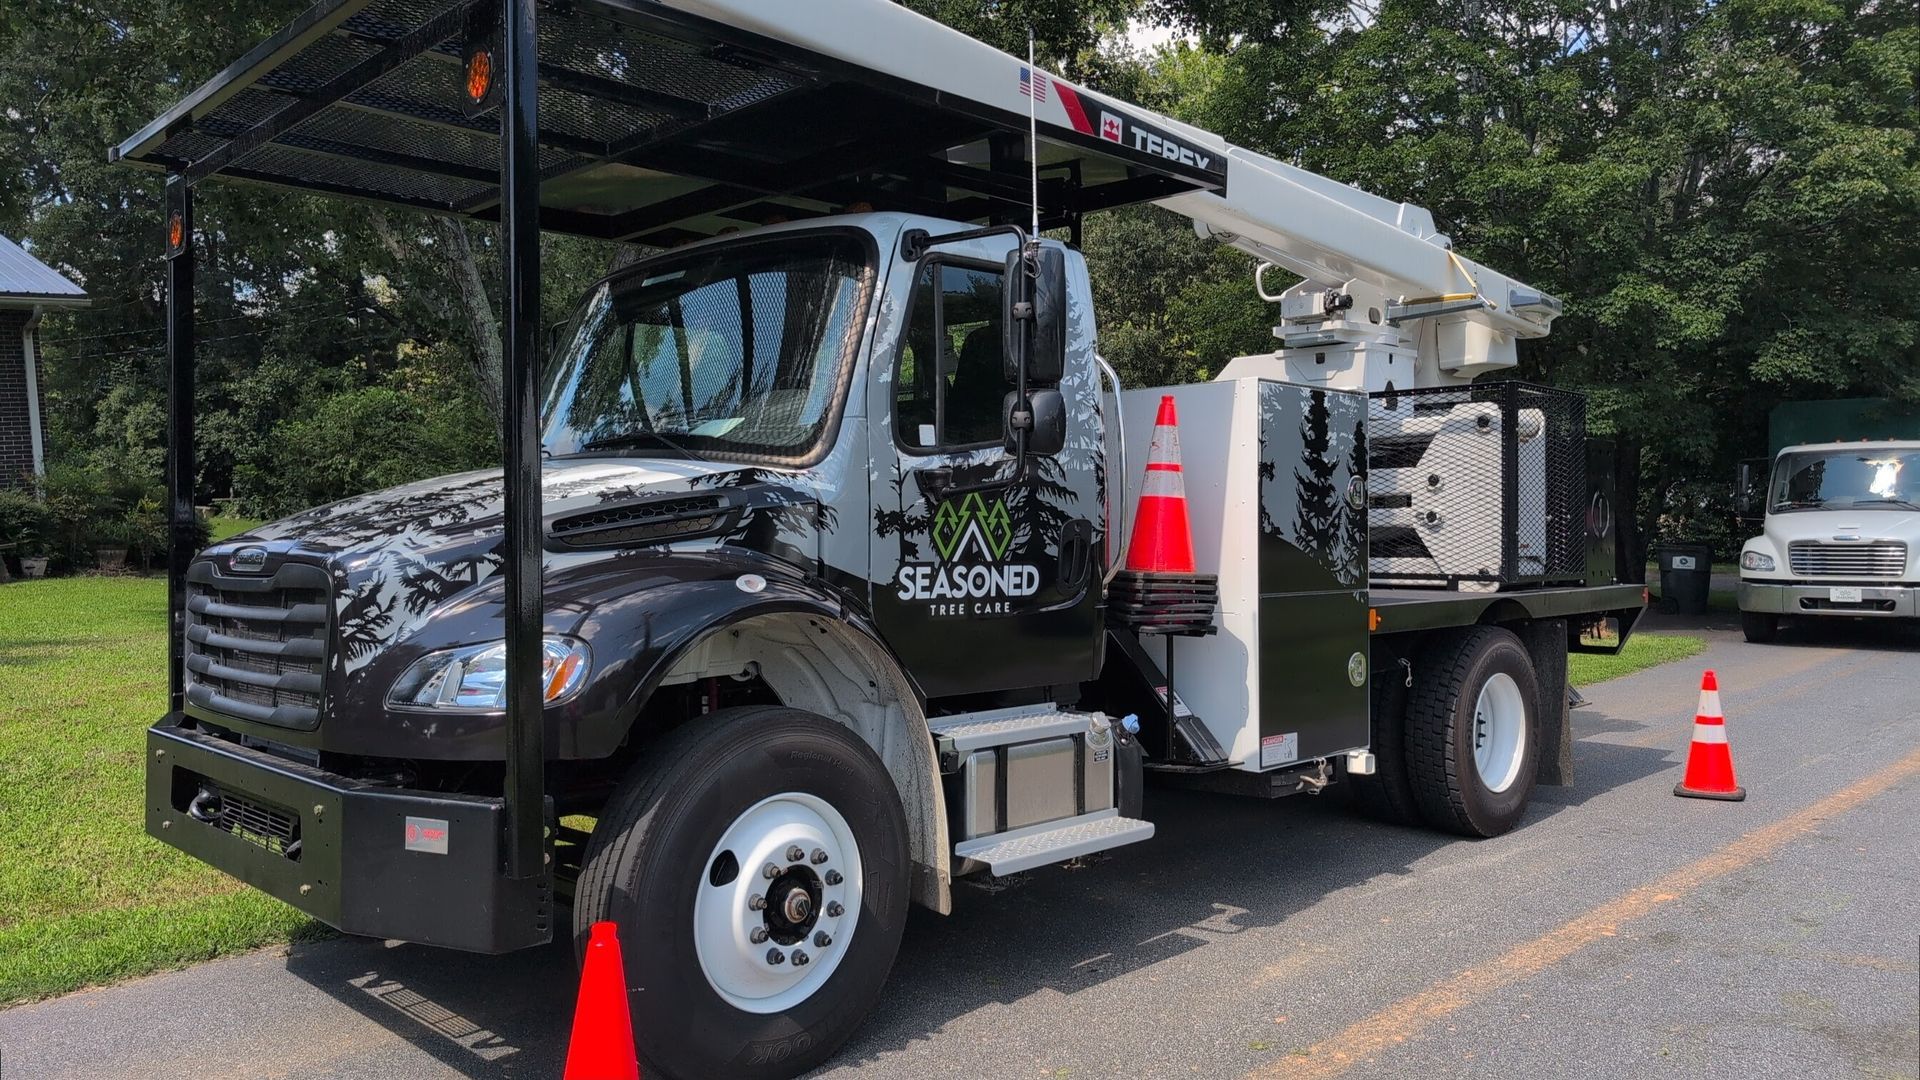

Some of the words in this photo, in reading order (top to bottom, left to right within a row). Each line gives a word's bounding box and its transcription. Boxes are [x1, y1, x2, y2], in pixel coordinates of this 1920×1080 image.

[898, 565, 1039, 600] SEASONED
[930, 604, 965, 616] TREE
[974, 602, 1010, 614] CARE
